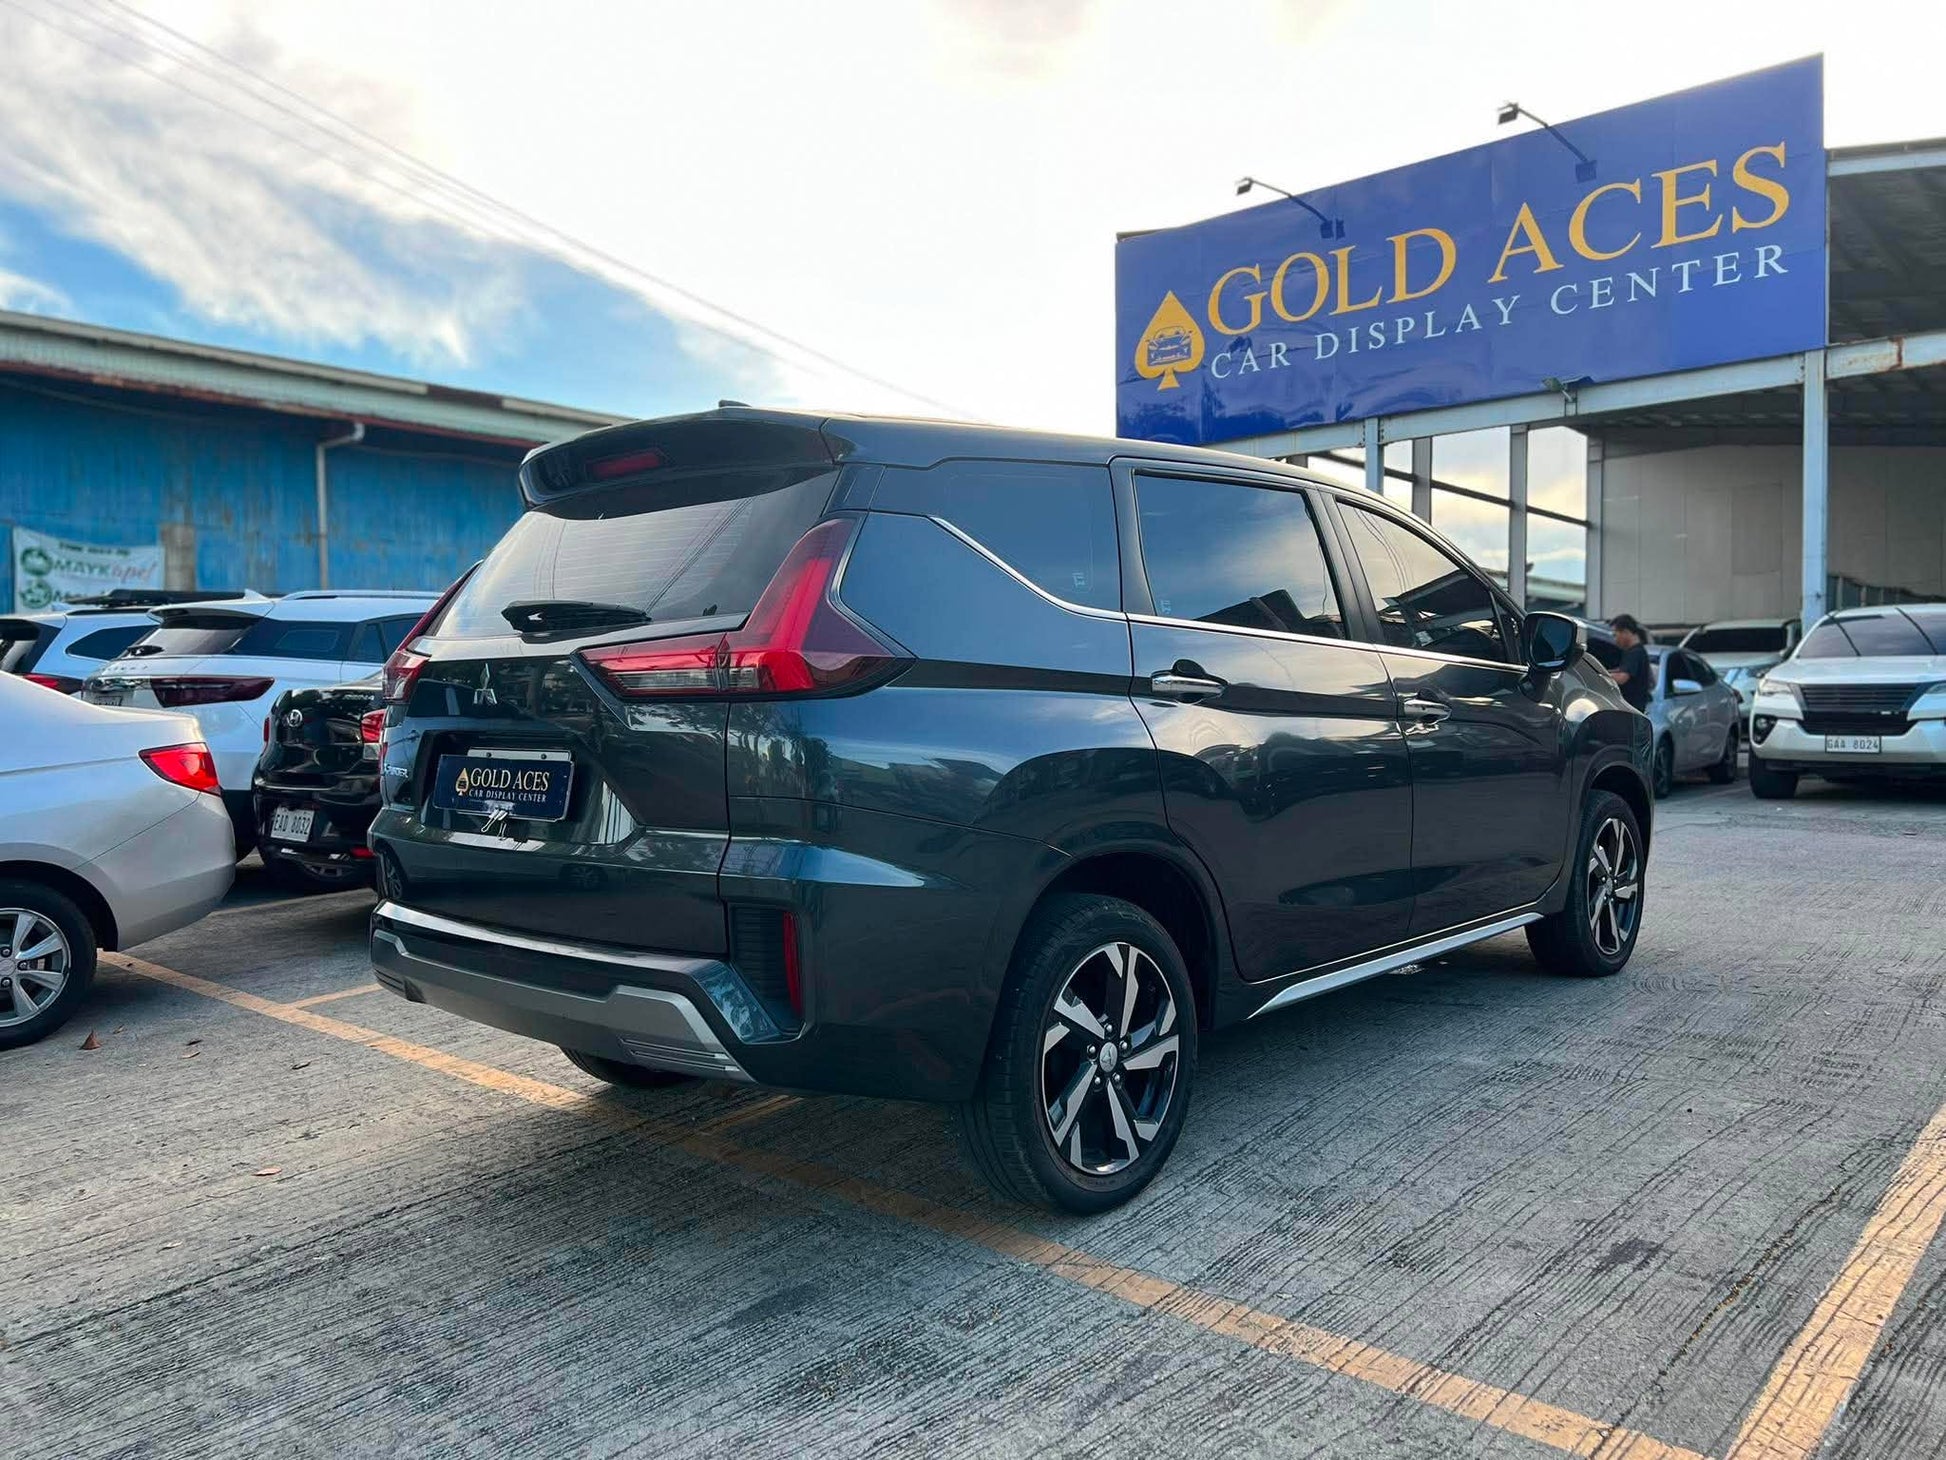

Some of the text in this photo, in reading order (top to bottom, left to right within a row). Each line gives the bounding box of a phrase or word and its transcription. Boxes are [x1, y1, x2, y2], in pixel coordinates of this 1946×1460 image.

[1207, 141, 1791, 335] GOLD ACES
[1211, 244, 1790, 380] CAR DISPLAY CENTER
[468, 788, 547, 803] CAR DISPLAY CENTER
[470, 767, 550, 792] GOLD ACES
